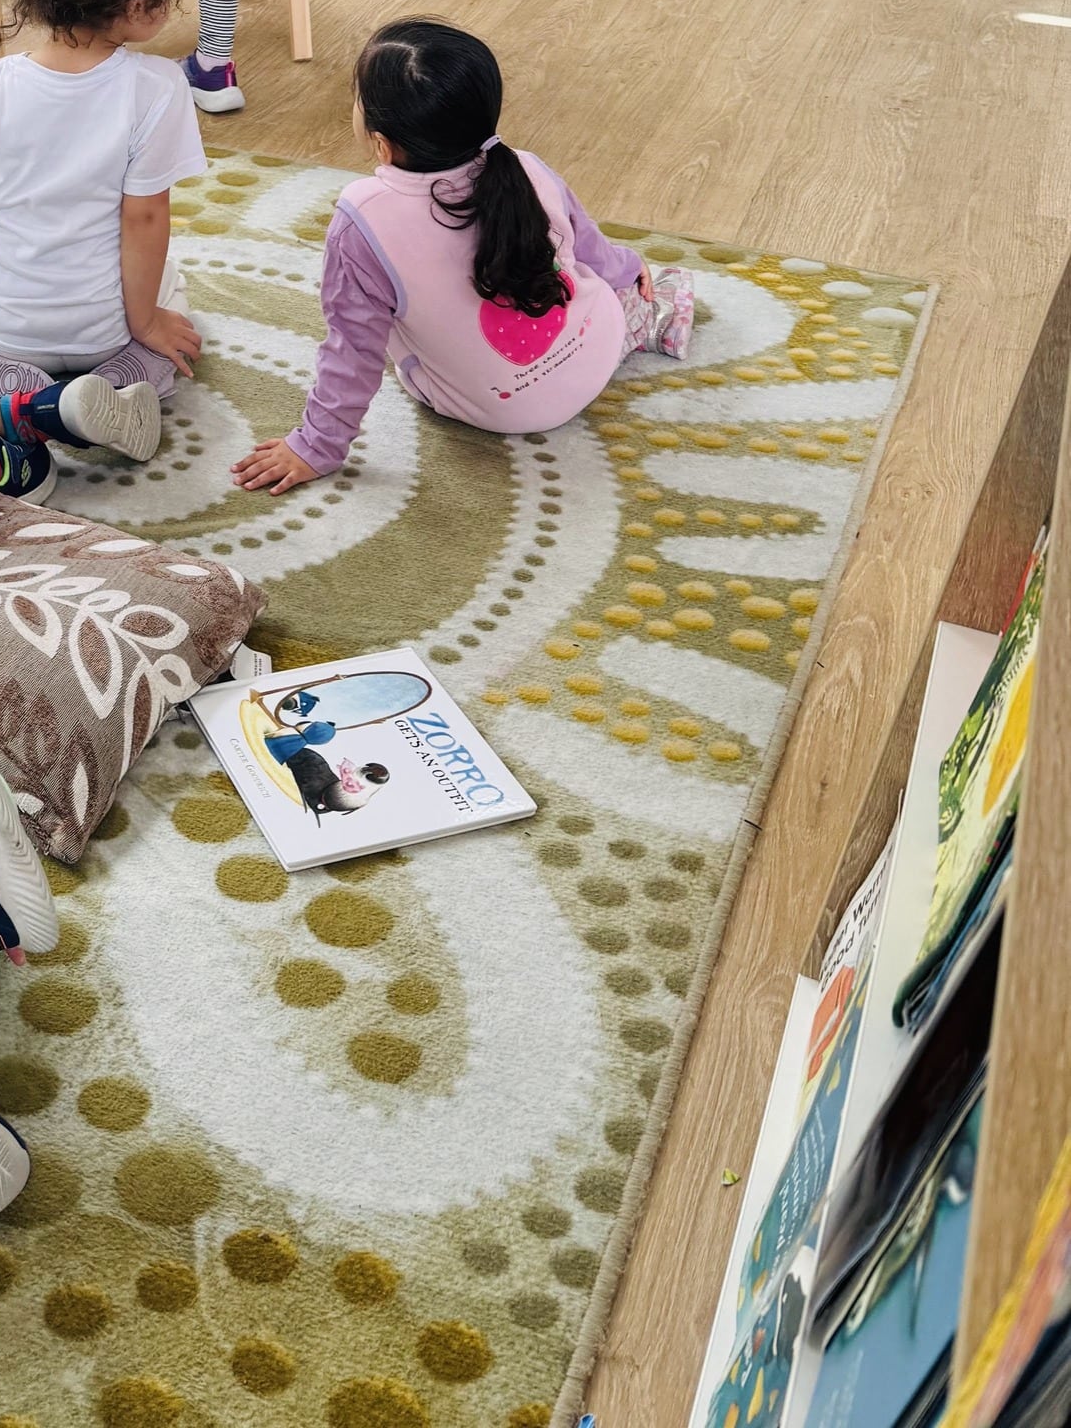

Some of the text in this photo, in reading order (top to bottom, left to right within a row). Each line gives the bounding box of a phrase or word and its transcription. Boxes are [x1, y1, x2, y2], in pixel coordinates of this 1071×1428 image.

[394, 719, 474, 813] GETS AN OUTFIT
[405, 712, 505, 806] ZORRO
[820, 930, 855, 993] Good
